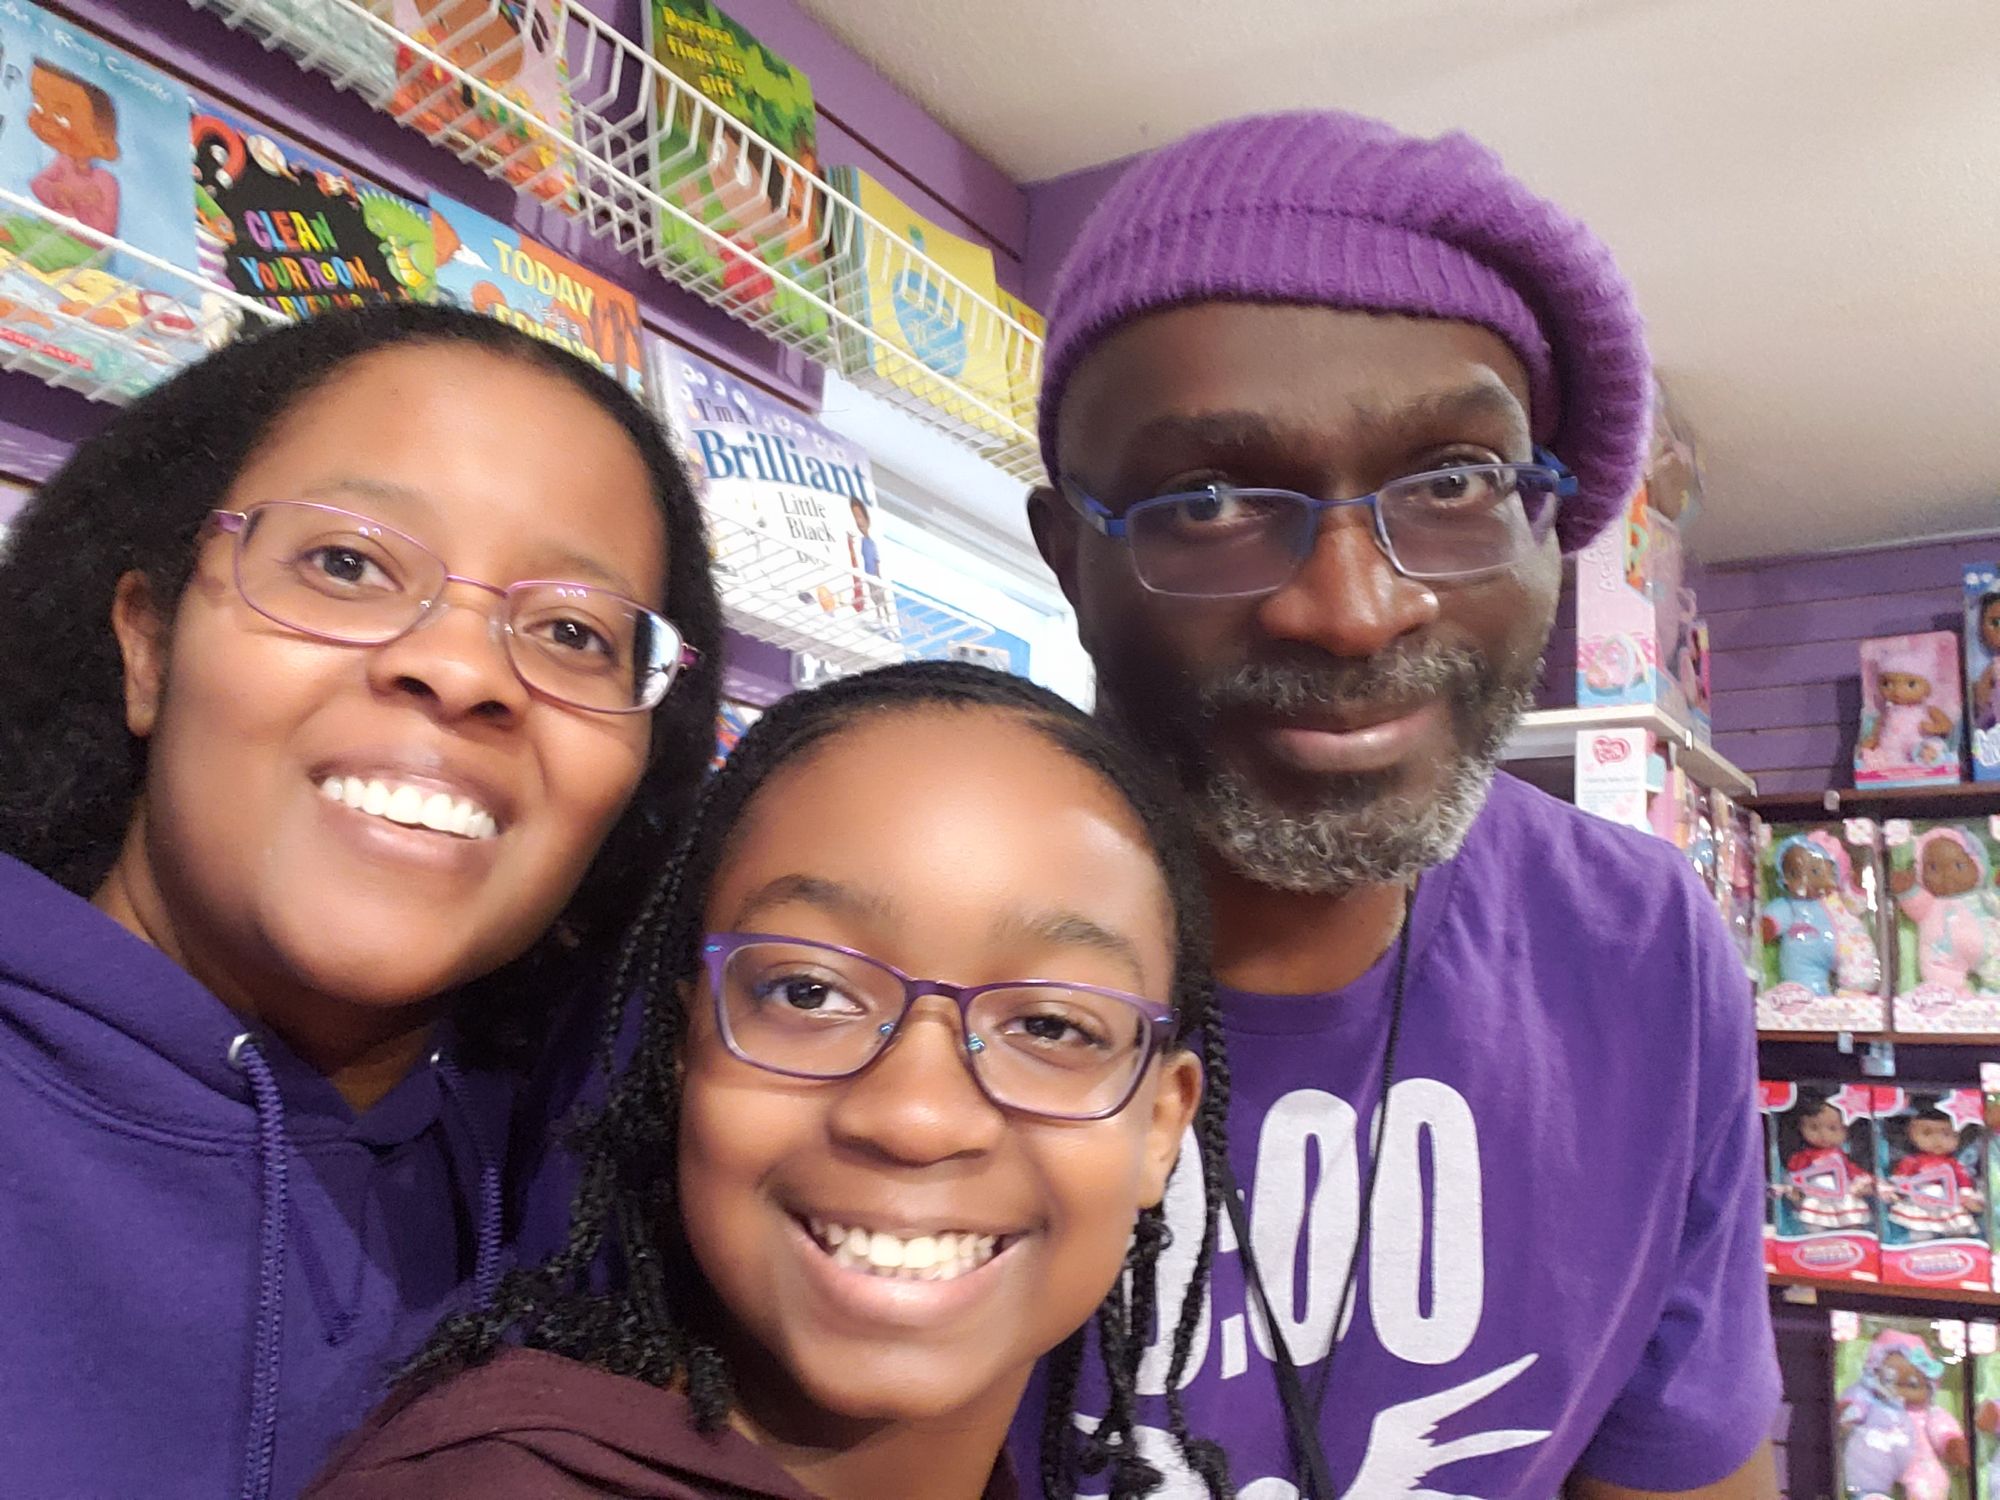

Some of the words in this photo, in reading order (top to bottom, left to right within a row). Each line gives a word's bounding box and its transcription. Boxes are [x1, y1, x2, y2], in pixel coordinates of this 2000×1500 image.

[243, 209, 339, 252] CLEAN
[238, 256, 311, 292] YOUR
[492, 237, 594, 318] TODAY
[691, 429, 873, 507] Brilliant
[778, 491, 826, 519] Little
[785, 516, 836, 543] Black
